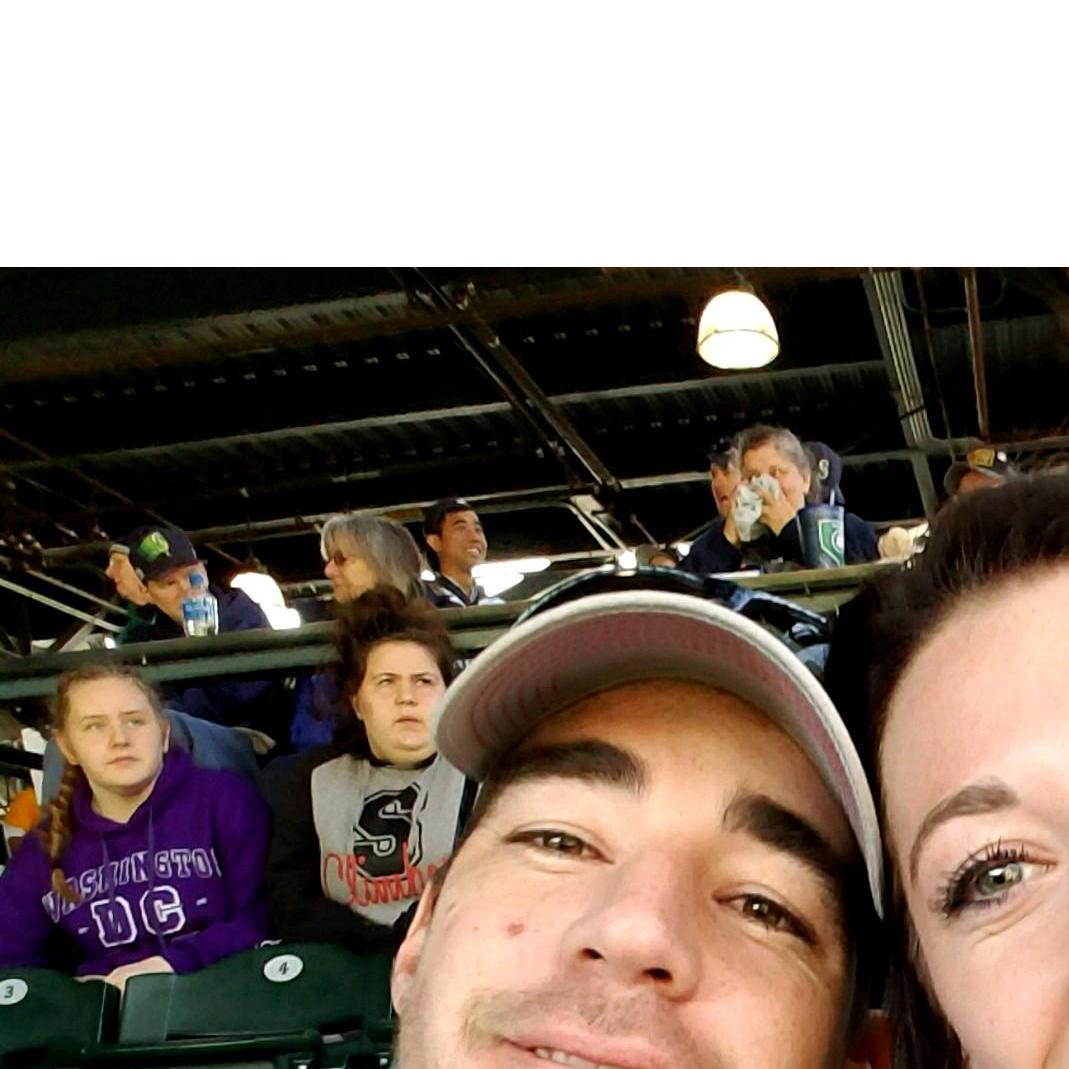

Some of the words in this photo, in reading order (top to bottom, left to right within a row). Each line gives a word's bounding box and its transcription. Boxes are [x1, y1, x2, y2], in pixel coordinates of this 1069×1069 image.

[353, 782, 425, 881] S
[278, 961, 290, 976] 4
[4, 985, 15, 999] 3
